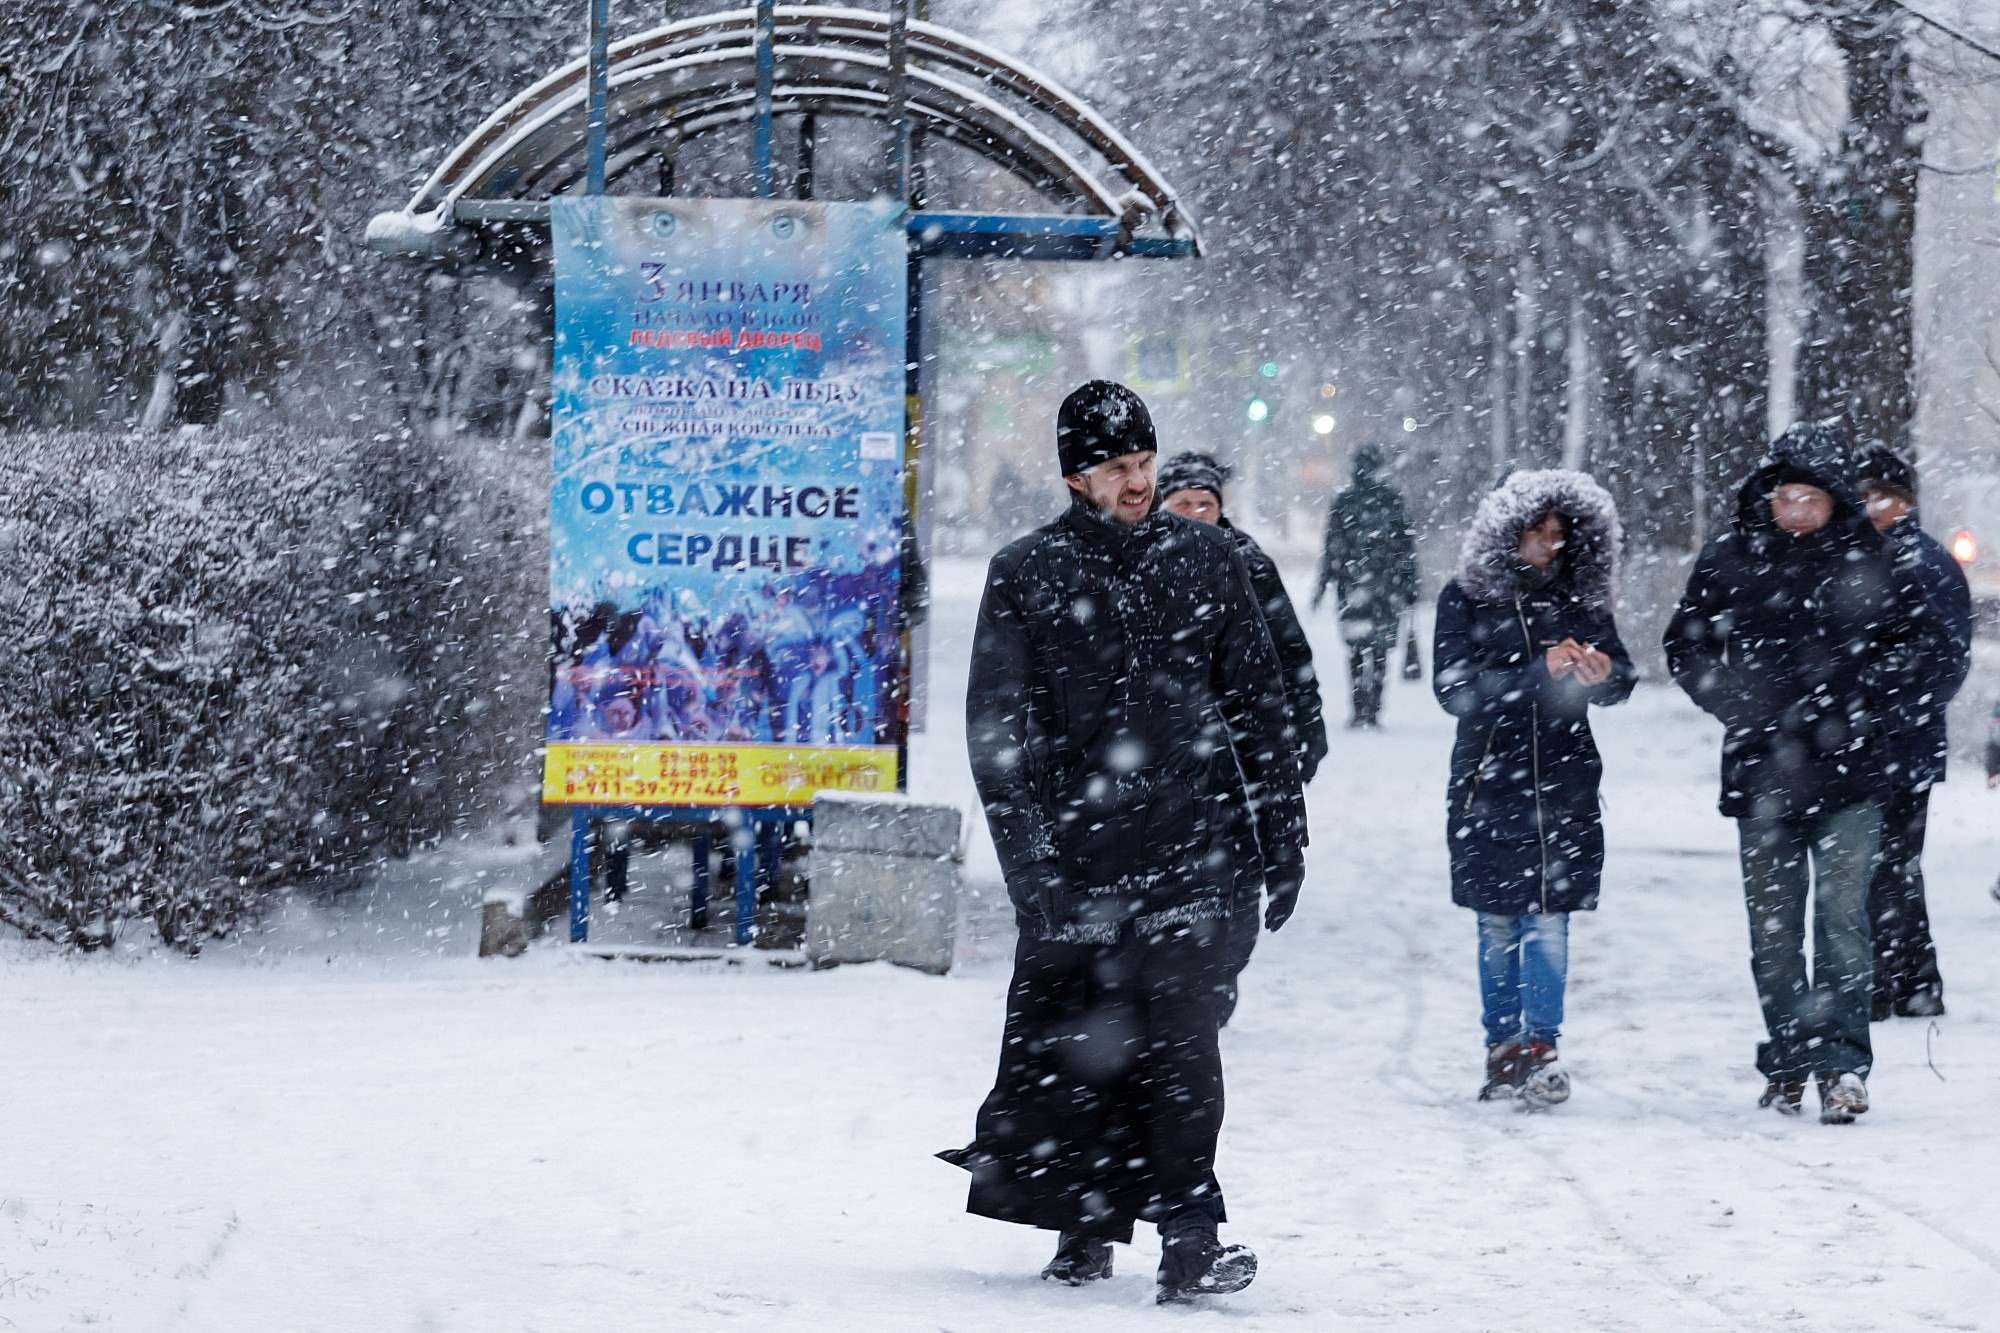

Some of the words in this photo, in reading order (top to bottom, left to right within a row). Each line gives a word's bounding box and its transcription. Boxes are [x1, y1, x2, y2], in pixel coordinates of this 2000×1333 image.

[640, 262, 666, 302] 3
[677, 281, 810, 303] ЯНВАРЯ
[629, 328, 731, 347] ЛЕДОВЫЙ
[736, 331, 822, 351] ДВОРЕЦ
[591, 376, 718, 399] СКАЗКА
[728, 378, 772, 400] НА
[783, 380, 864, 404] ЛЬДУ
[581, 482, 859, 518] ОТВАЖНОЕ
[627, 533, 810, 572] СЕРДЦЕ
